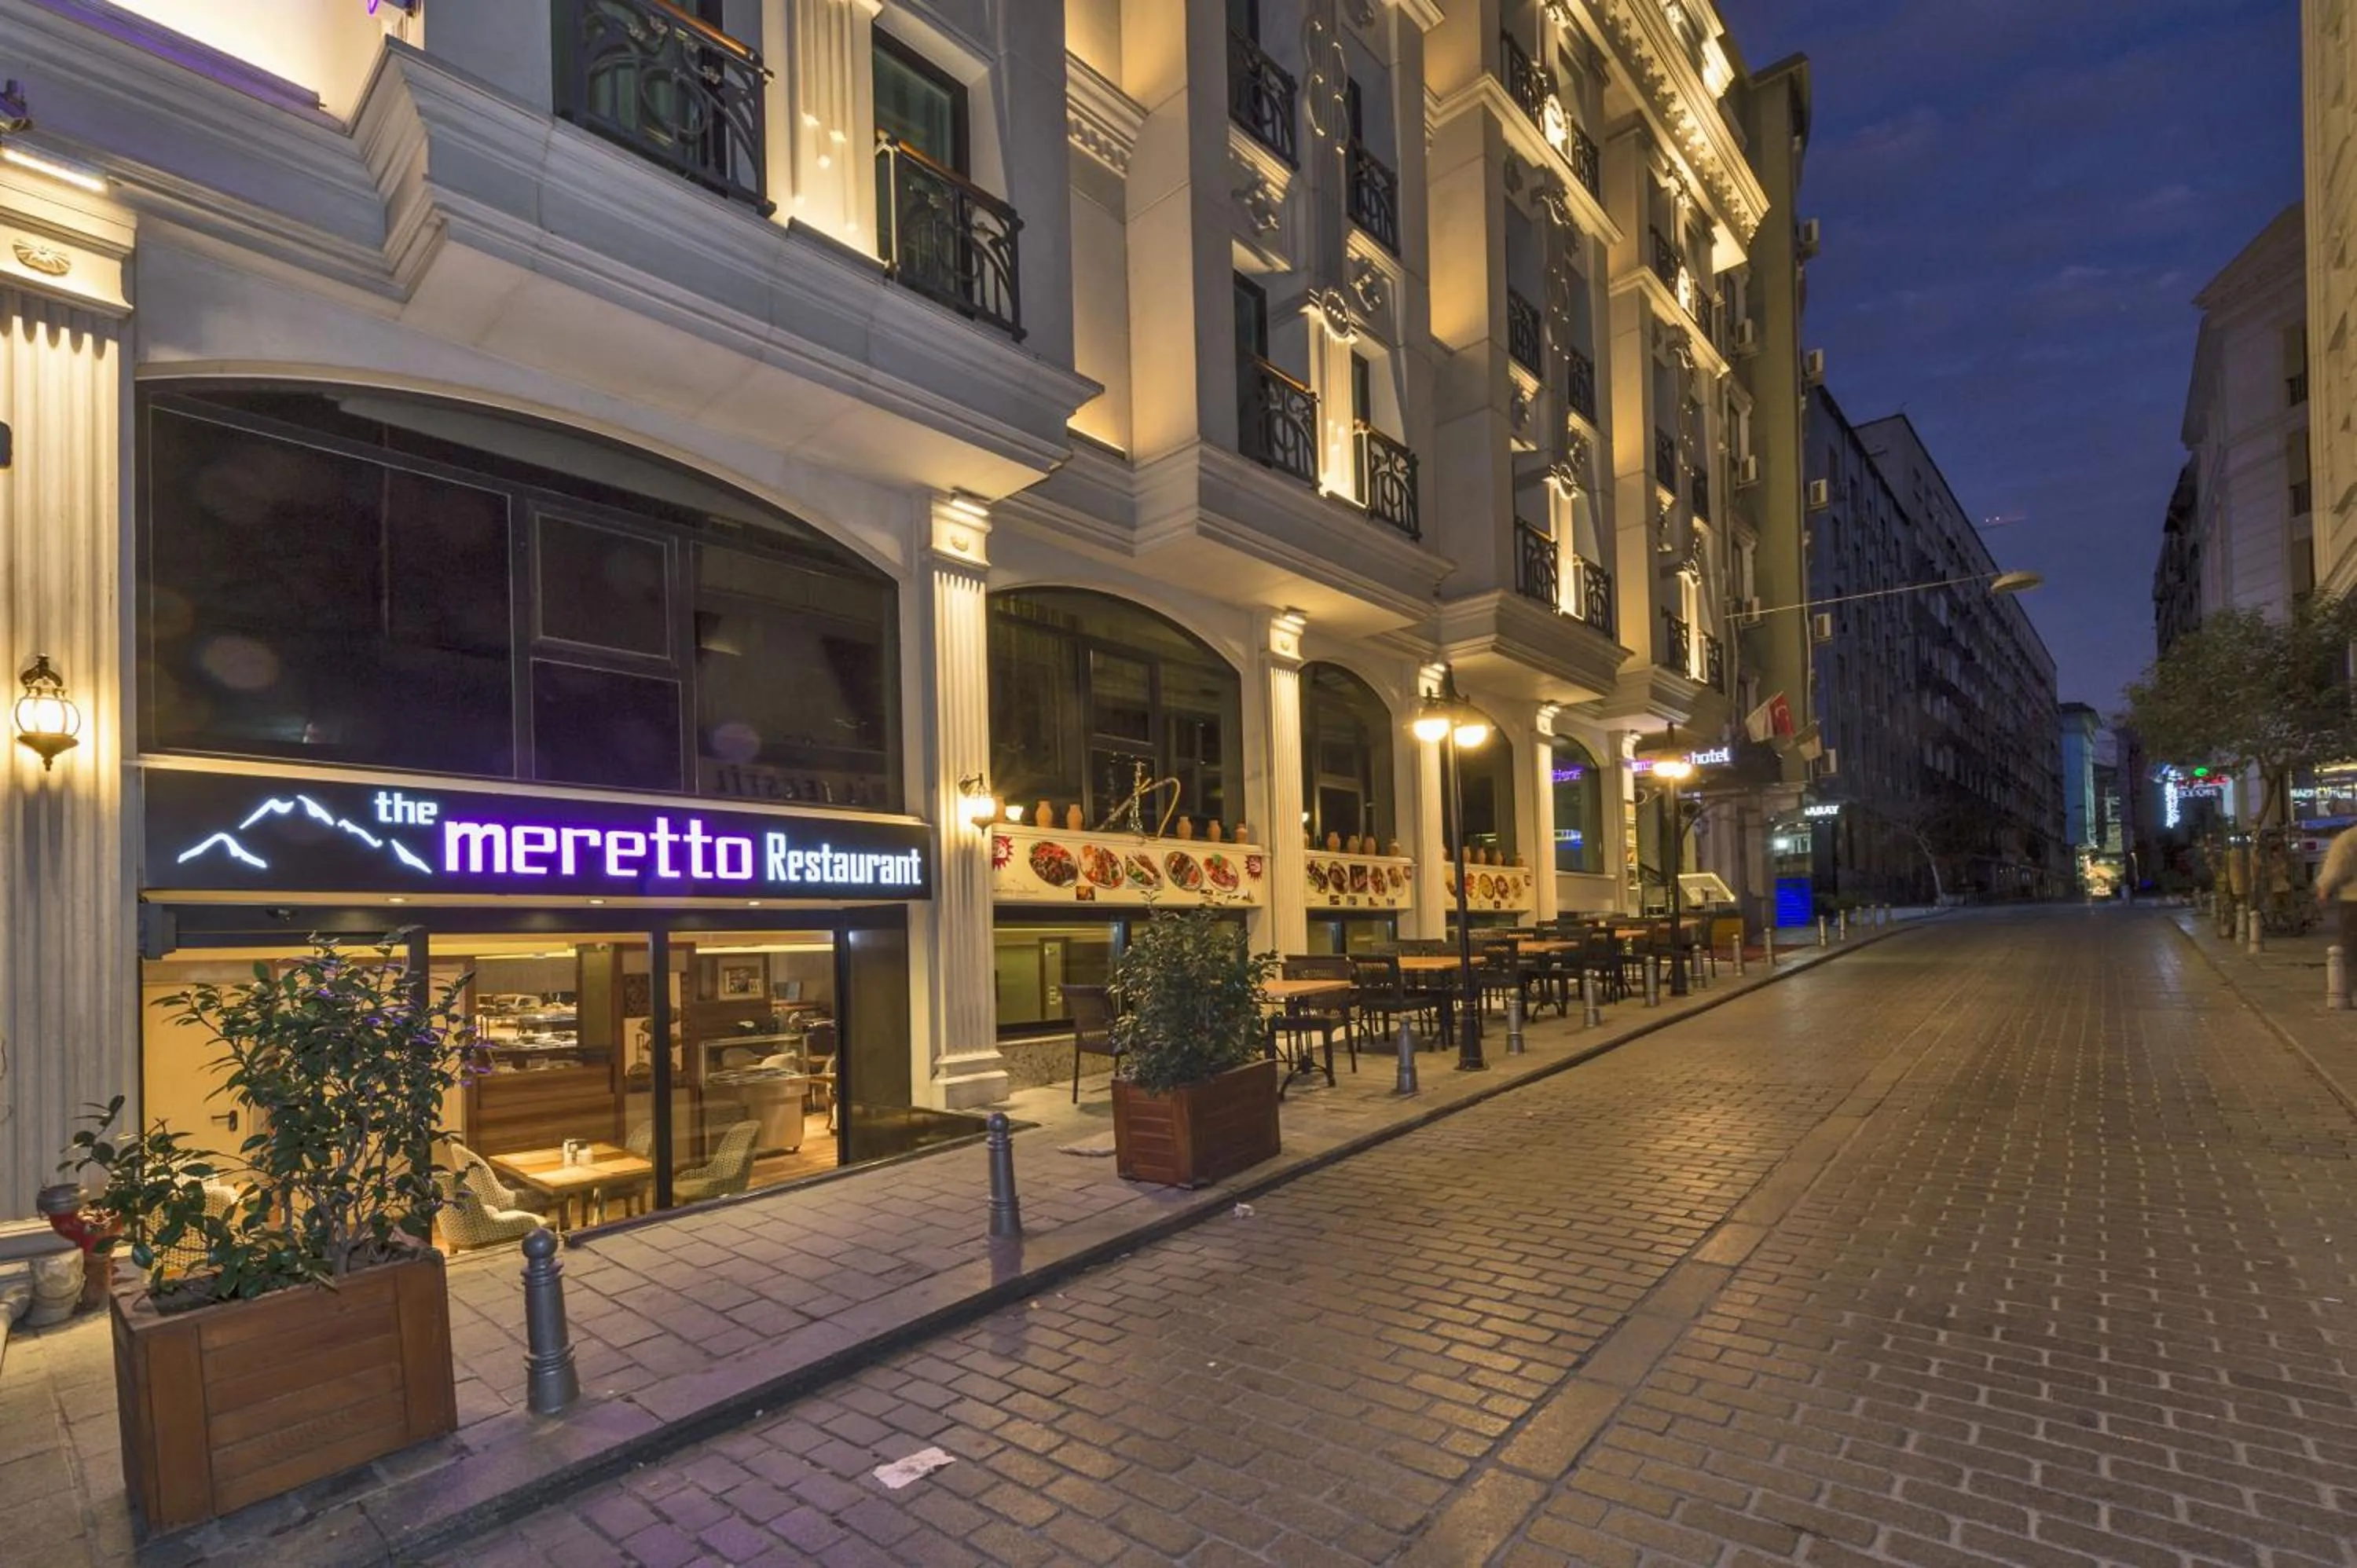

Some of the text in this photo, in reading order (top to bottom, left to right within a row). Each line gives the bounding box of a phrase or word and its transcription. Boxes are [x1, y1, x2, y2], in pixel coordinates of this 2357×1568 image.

[1691, 747, 1730, 764] hotel
[374, 790, 922, 886] the meretto Restaurant
